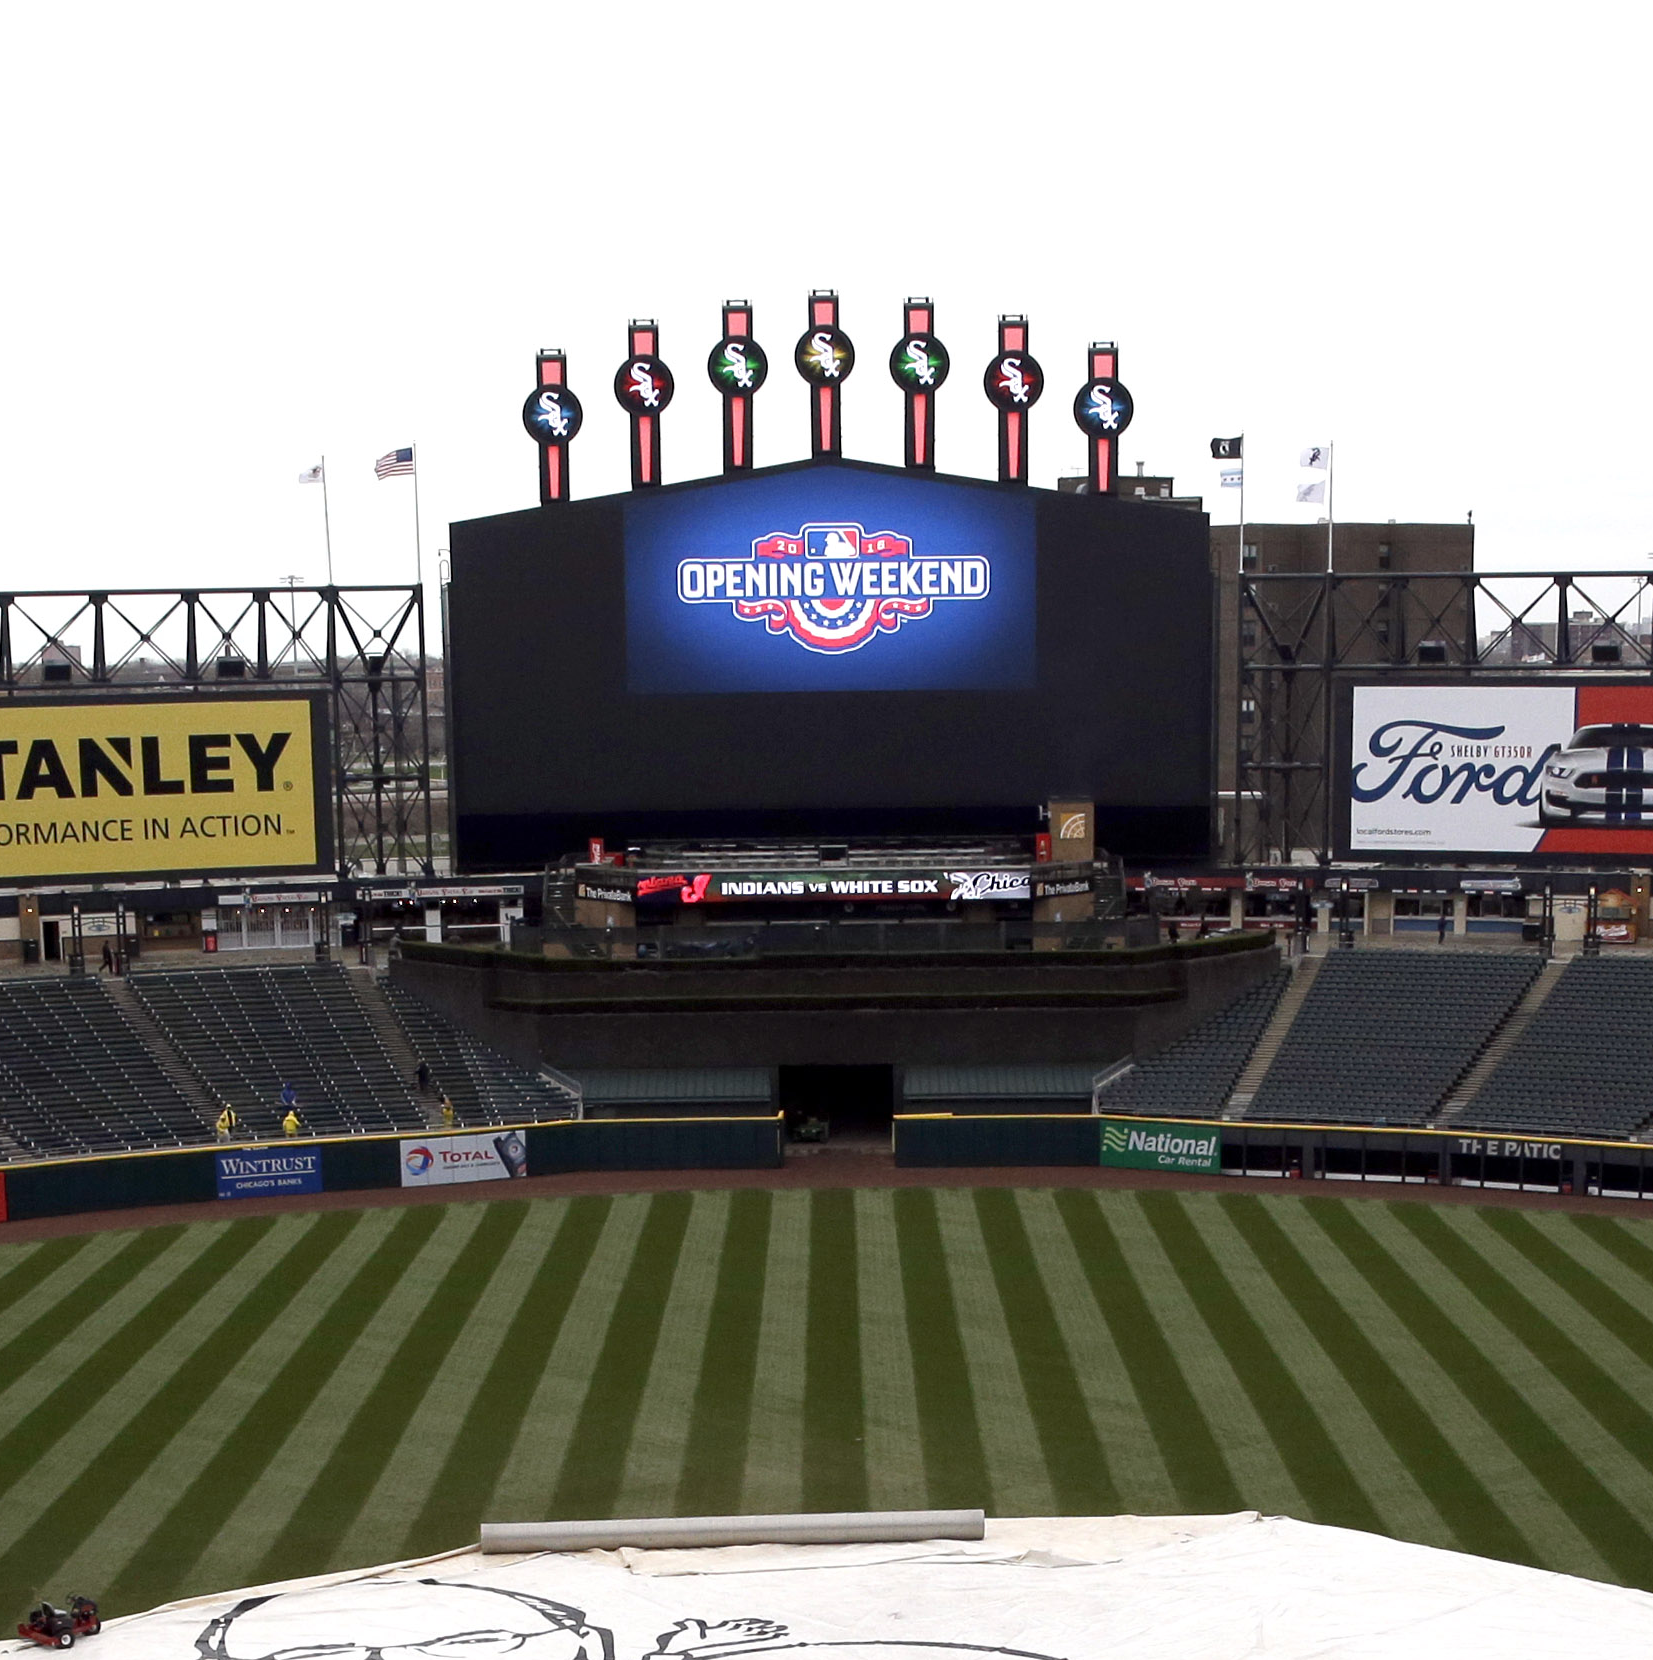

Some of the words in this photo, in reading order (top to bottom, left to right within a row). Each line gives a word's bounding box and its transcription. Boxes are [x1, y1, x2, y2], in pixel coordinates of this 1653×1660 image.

[682, 562, 825, 598] OPENING
[829, 561, 986, 597] WEEKEND
[1451, 745, 1488, 757] SHELBY
[1351, 720, 1559, 806] Ford
[144, 817, 169, 841] IN
[180, 814, 283, 839] ACTION
[587, 886, 597, 899] The
[721, 882, 804, 895] INDIANS
[831, 880, 894, 894] WHITE
[898, 880, 939, 894] SOX
[1045, 884, 1055, 895] The
[1128, 1130, 1216, 1157] National
[438, 1150, 495, 1163] TOTAL
[1157, 1156, 1175, 1165] Car
[1178, 1157, 1212, 1168] Rental
[220, 1156, 316, 1175] WINTRUST
[278, 1178, 302, 1186] BANKS
